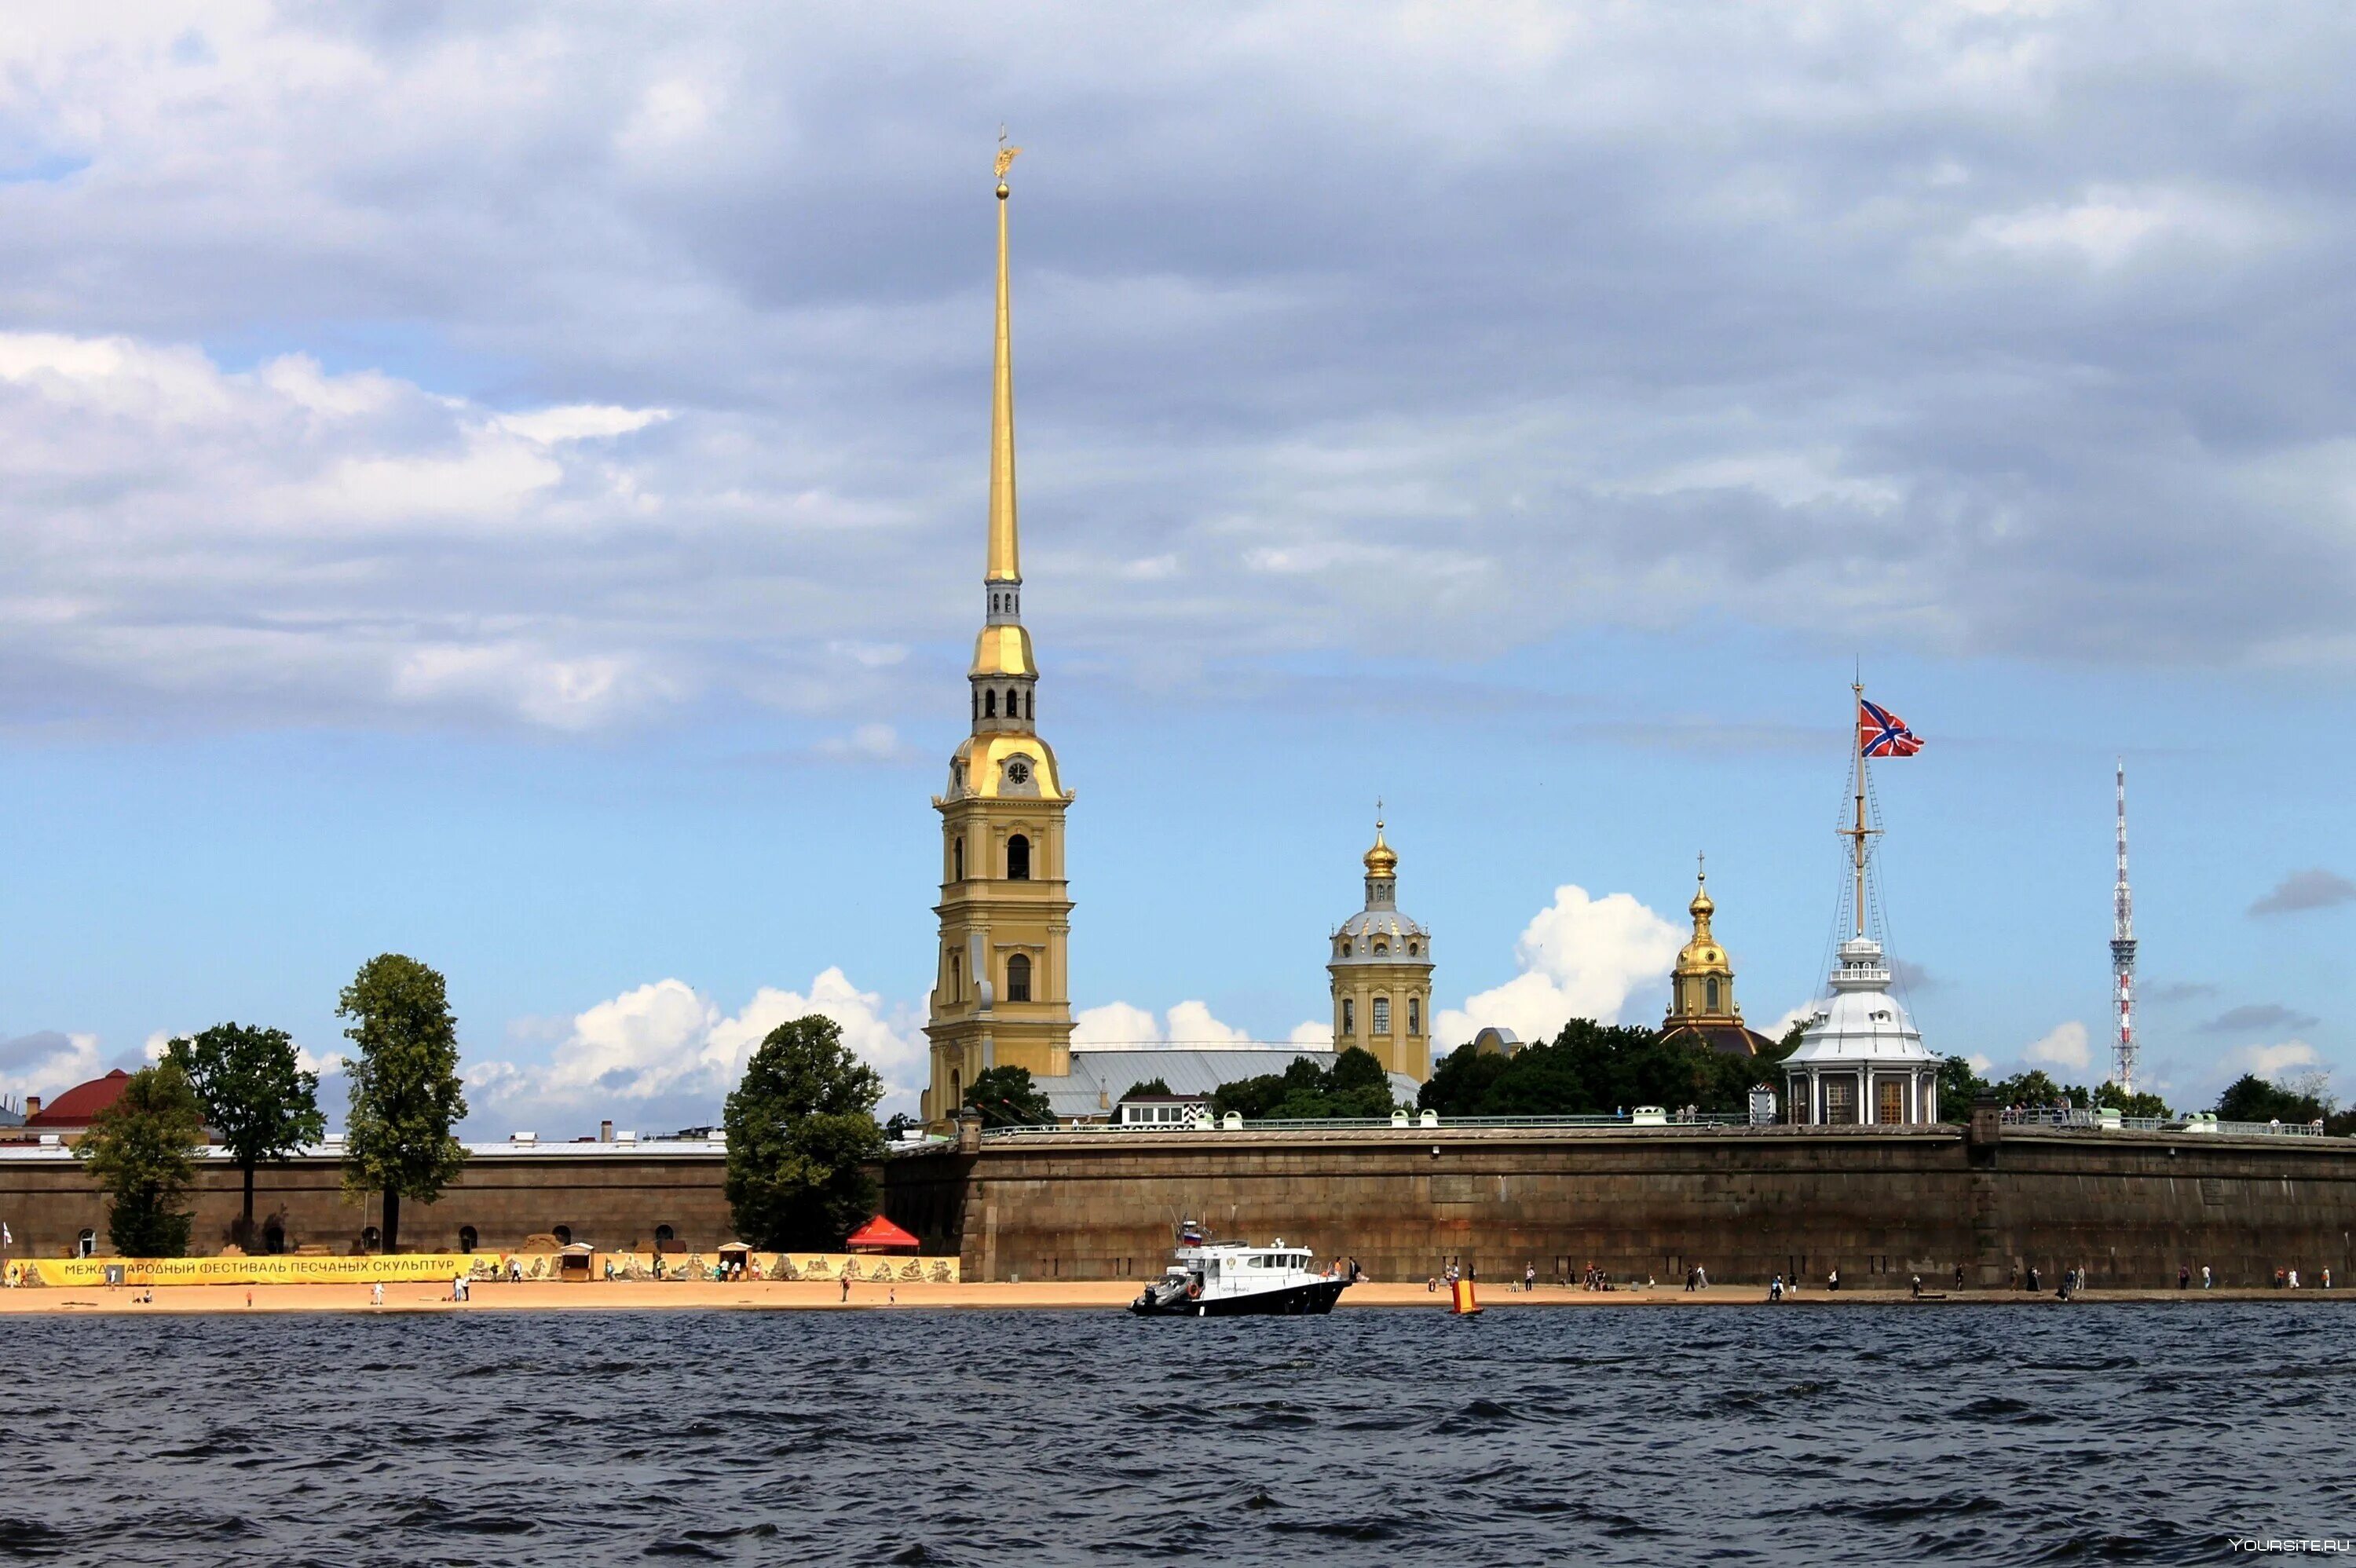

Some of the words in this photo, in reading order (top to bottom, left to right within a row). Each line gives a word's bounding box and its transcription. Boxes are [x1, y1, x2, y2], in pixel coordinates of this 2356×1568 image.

[64, 1263, 195, 1275] МЕЖДАРОДНЫЙ
[199, 1262, 286, 1273] ФЕСТИВАЛЬ
[291, 1262, 368, 1272] ПЕСЧАНЫХ
[373, 1260, 454, 1272] СКУЛЬПТУР
